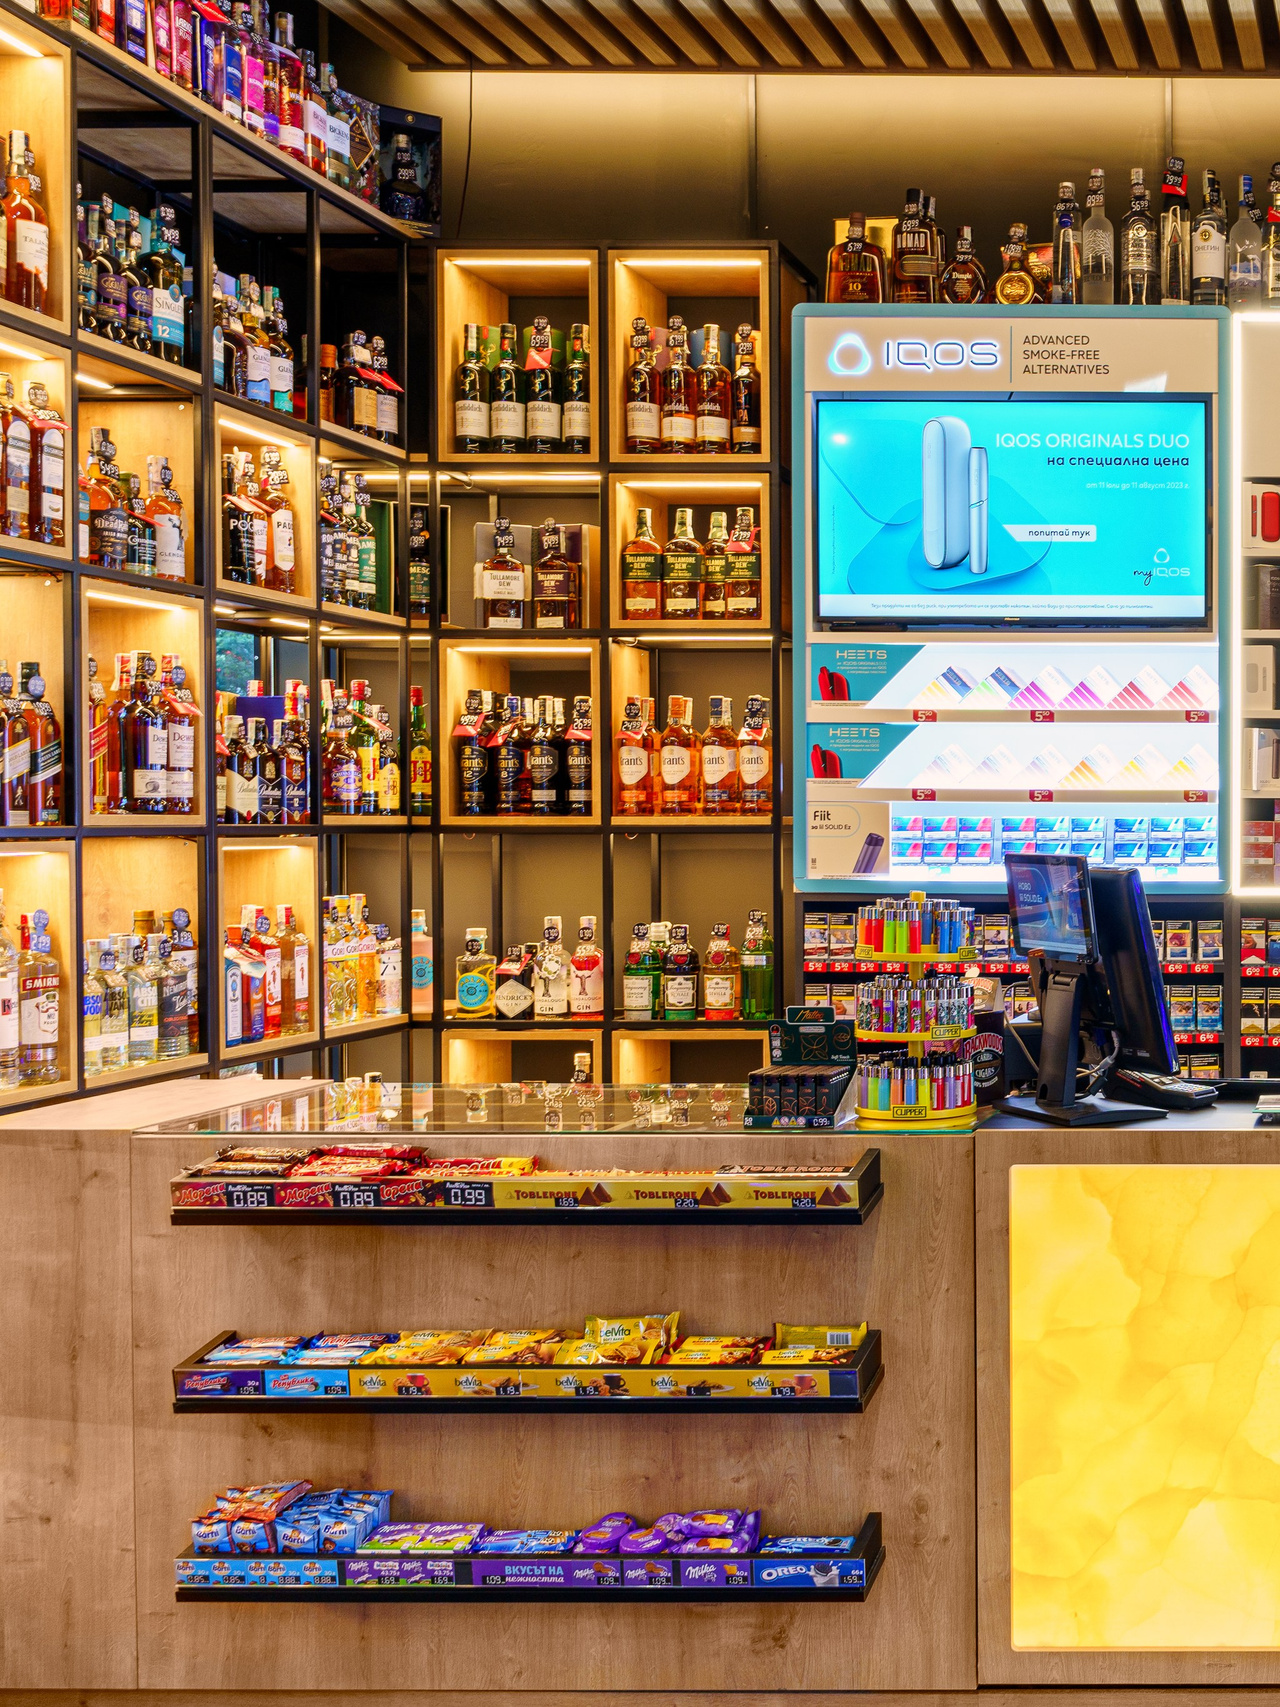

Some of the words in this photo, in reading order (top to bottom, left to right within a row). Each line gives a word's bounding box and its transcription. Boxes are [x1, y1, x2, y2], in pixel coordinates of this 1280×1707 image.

[897, 234, 926, 248] NOMAD
[1023, 334, 1090, 346] ADVANCED
[885, 341, 998, 370] IQOS
[1023, 350, 1099, 360] SMOKE-FREE
[1023, 364, 1109, 375] ALTERNATIVES
[996, 434, 1041, 448] IQOS
[1046, 433, 1143, 448] ORIGINALS
[1149, 434, 1190, 448] DUO
[1048, 456, 1065, 466] на
[1070, 456, 1149, 469] специална
[1154, 456, 1189, 468] цена
[1029, 528, 1070, 538] попитай
[1072, 529, 1091, 538] тук
[490, 573, 520, 581] TULLAMORE
[836, 650, 887, 659] HEETS
[813, 811, 831, 821] Fiit
[975, 1067, 994, 1077] CIGARS
[181, 1183, 226, 1202] Морена
[451, 1191, 485, 1205] 0.99
[634, 1190, 697, 1199] TOBLERONE
[234, 1194, 267, 1207] 0.89
[185, 1376, 228, 1390] Република
[651, 1376, 678, 1387] belVita
[505, 1564, 545, 1575] ВКУСЪТ
[548, 1566, 563, 1574] НА
[686, 1565, 716, 1579] Milka
[761, 1567, 806, 1579] OREO
